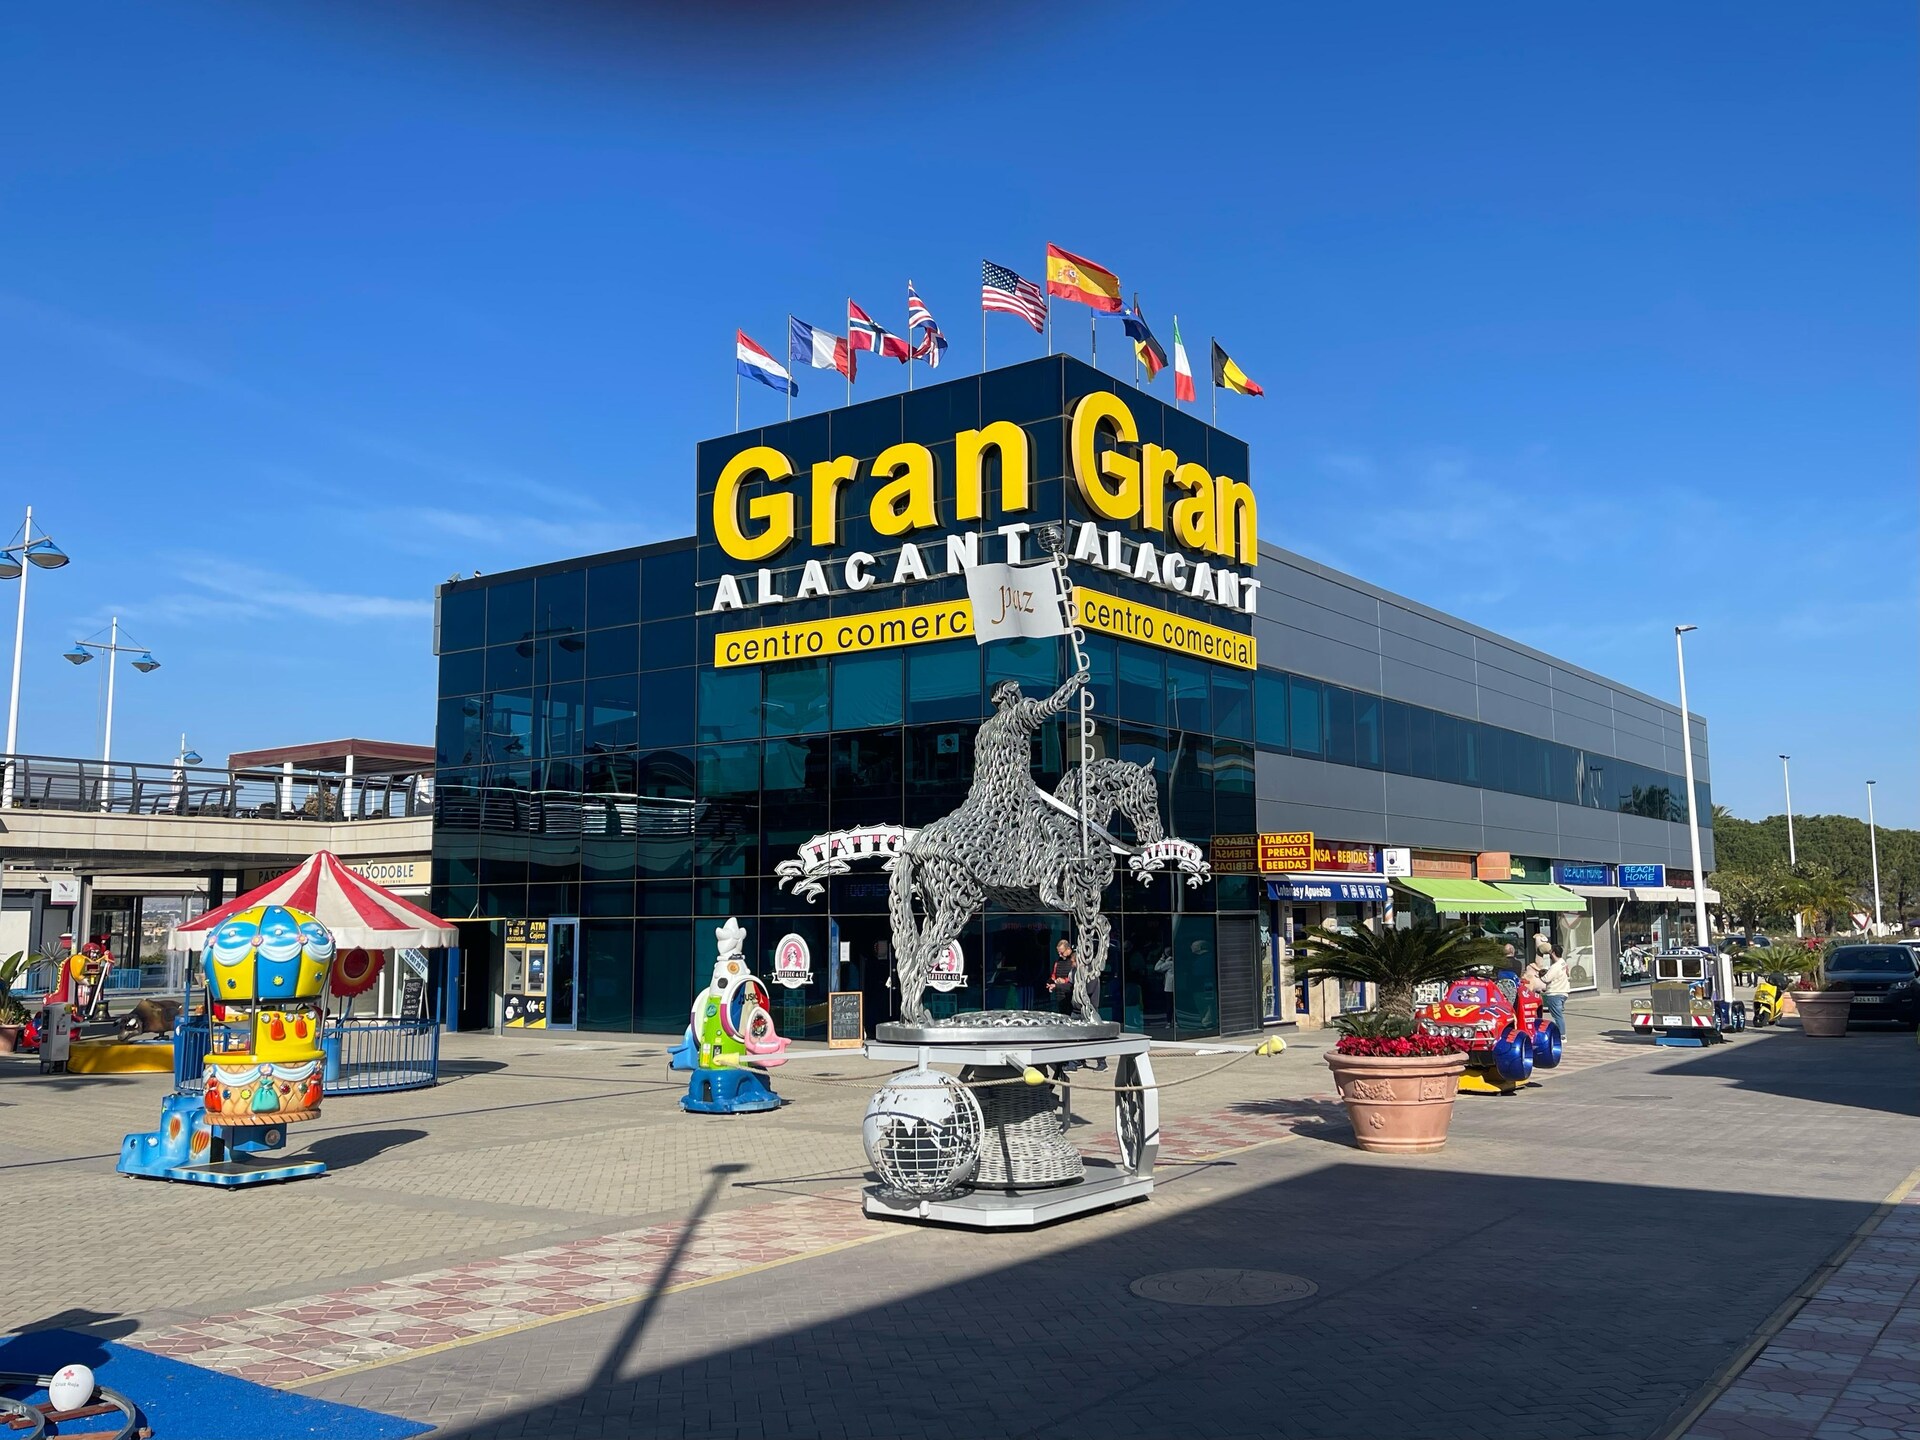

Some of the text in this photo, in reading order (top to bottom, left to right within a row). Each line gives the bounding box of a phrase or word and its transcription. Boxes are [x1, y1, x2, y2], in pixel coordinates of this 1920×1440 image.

[1071, 391, 1259, 567] Gran
[713, 420, 1031, 561] Gran
[711, 522, 1030, 612] ALACANT
[1073, 521, 1261, 614] ALACANT
[991, 585, 1034, 625] paz
[726, 610, 975, 662] centro comerc
[1084, 600, 1254, 666] centro comercial
[1264, 834, 1309, 845] TABACOS
[807, 834, 907, 862] TATTO
[1145, 842, 1198, 861] TATTOO
[1267, 847, 1306, 857] PRENSA
[1266, 859, 1307, 870] BEBIDAS
[1314, 851, 1331, 863] NSA
[1337, 851, 1368, 865] BEBIDAS
[352, 864, 414, 880] PASODOBLE
[1624, 865, 1655, 873] BEACH
[1625, 873, 1655, 881] HOME
[1304, 884, 1332, 899] Apuestas
[530, 922, 546, 931] ATM
[529, 932, 546, 940] Cajero
